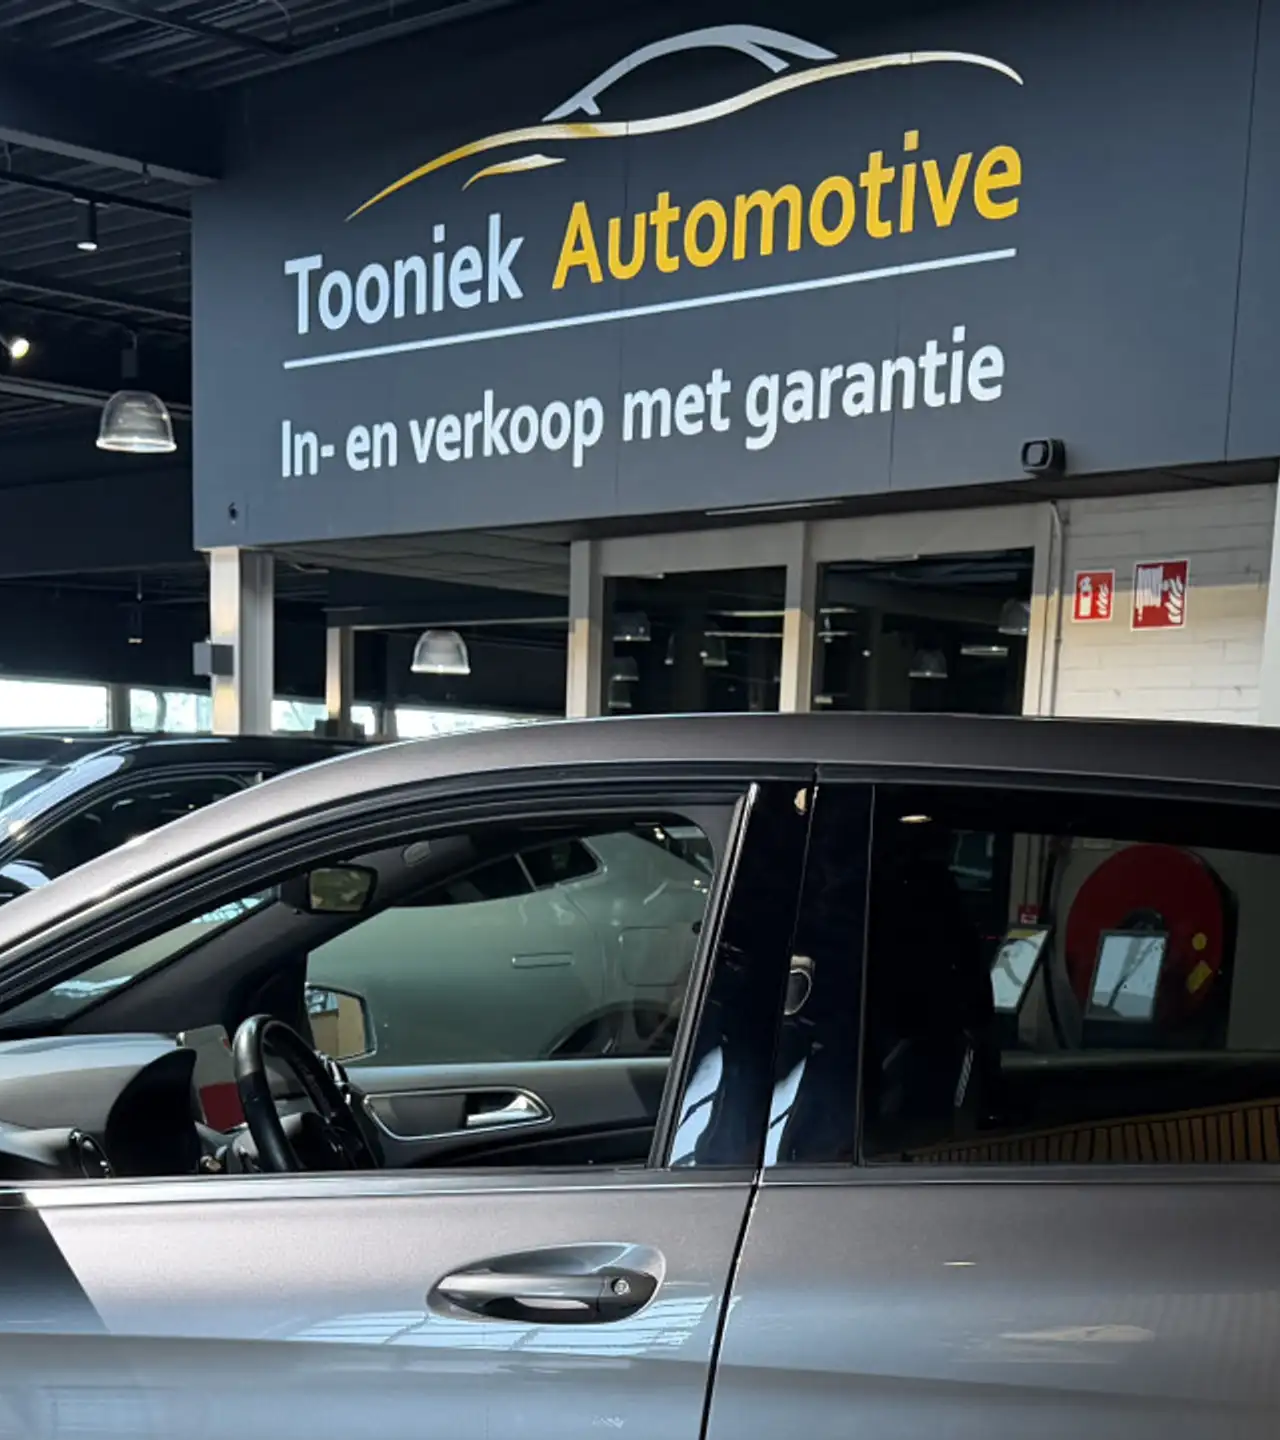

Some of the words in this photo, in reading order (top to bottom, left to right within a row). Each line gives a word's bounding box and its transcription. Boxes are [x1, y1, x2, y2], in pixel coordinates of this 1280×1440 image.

[283, 212, 525, 336] Tooniek
[551, 128, 1023, 291] Automotive
[281, 418, 336, 479] In-
[345, 421, 399, 472] en
[408, 387, 606, 470] verkoop
[622, 366, 733, 444] met
[743, 323, 1007, 452] garantie
